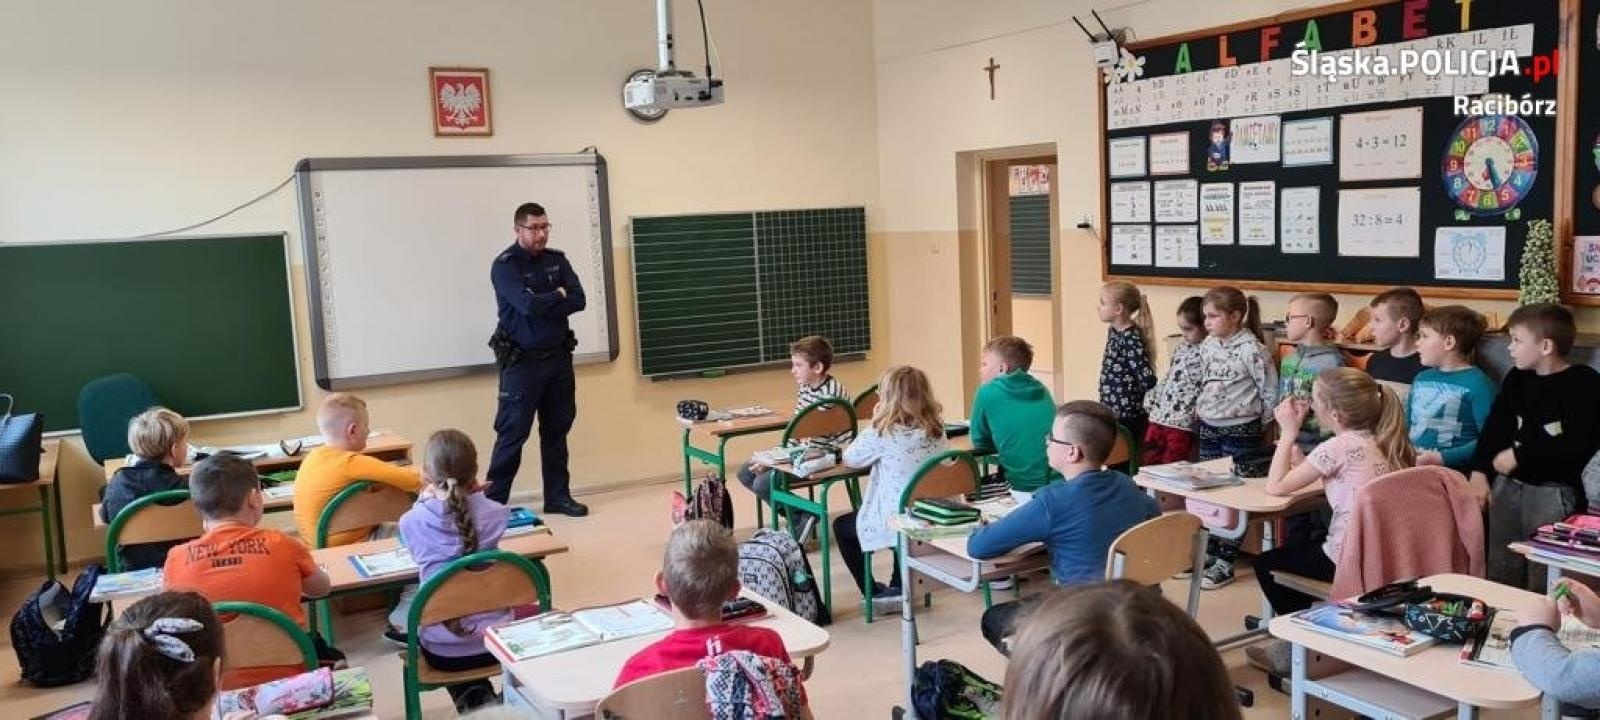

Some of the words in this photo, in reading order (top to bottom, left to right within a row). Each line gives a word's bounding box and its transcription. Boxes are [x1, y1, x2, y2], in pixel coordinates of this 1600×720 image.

[1394, 133, 1408, 149] 12
[186, 542, 219, 566] NEW
[228, 537, 271, 557] YORK
